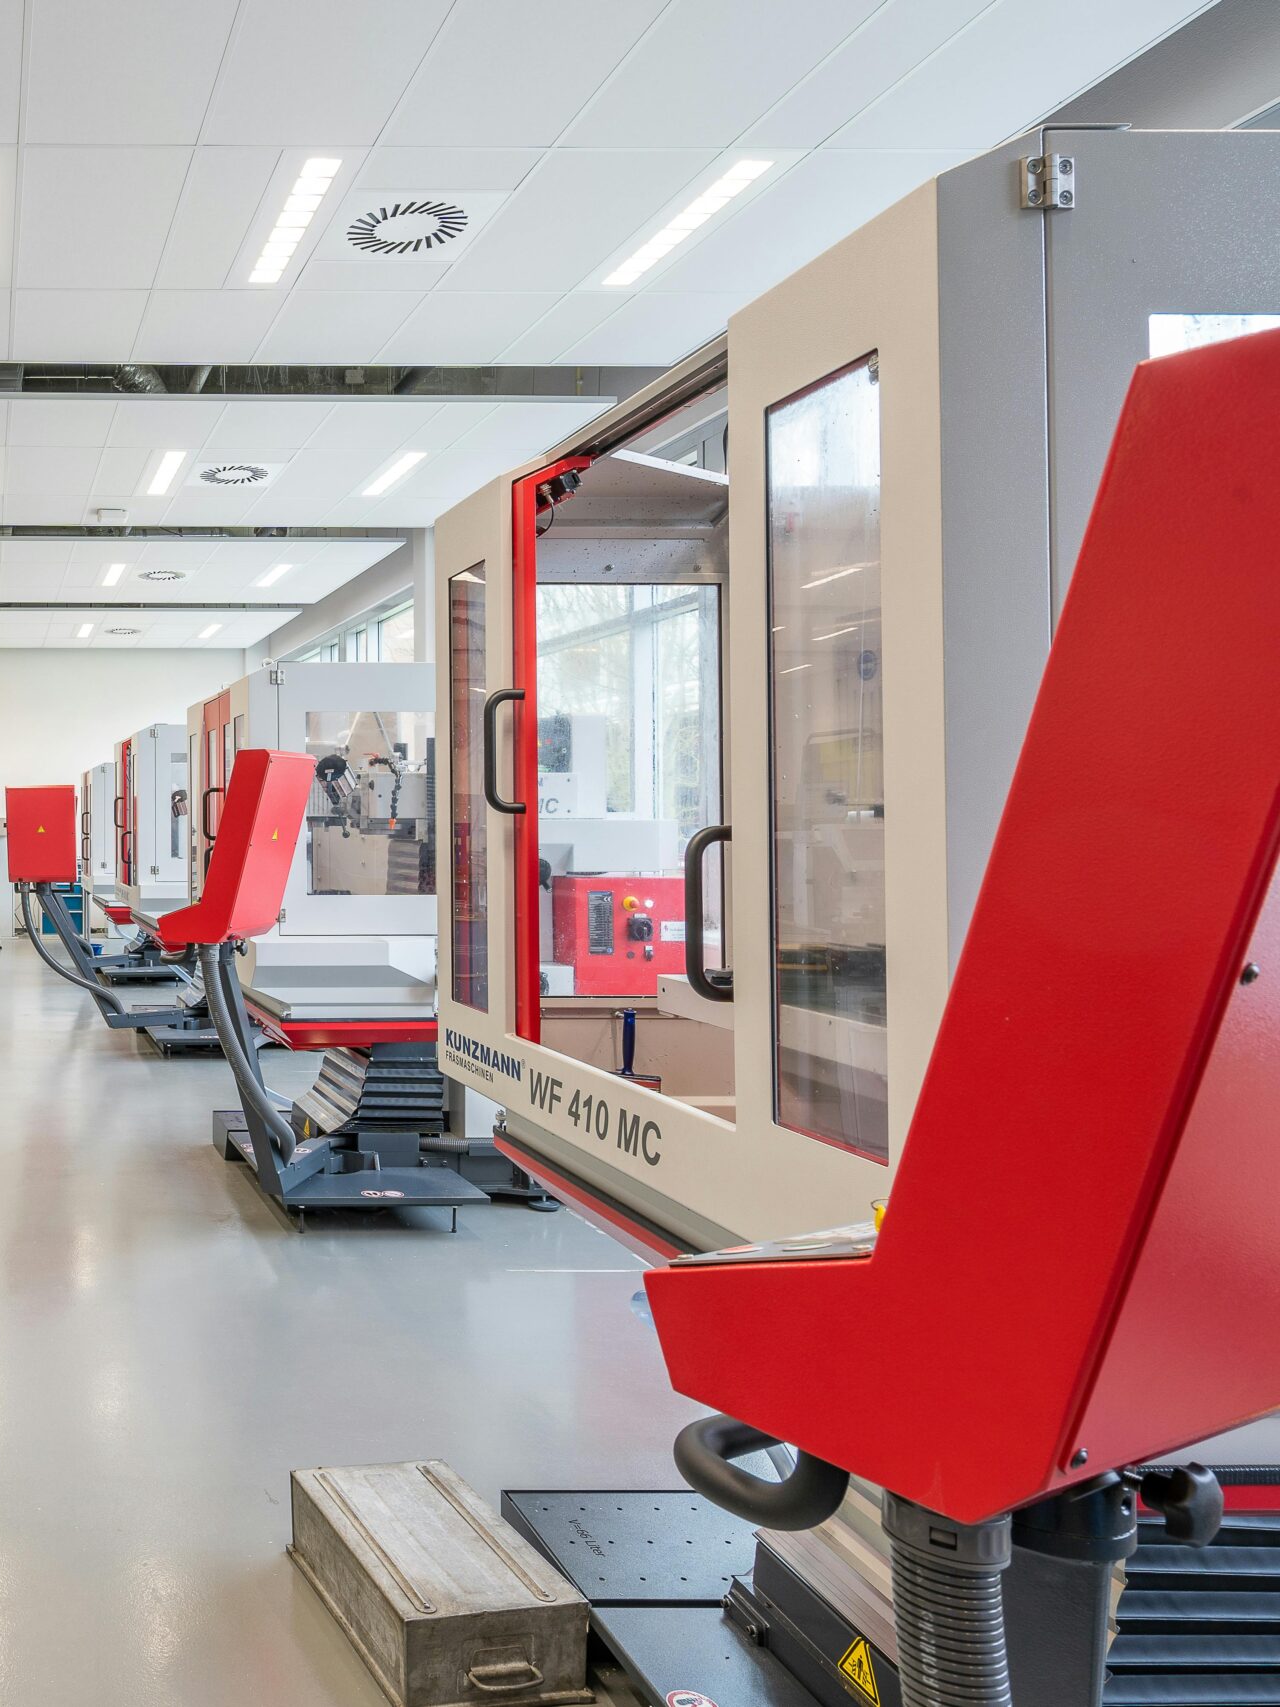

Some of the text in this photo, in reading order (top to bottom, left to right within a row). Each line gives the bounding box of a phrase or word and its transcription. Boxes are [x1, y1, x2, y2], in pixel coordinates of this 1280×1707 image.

[445, 1050, 494, 1083] FRÄSMASCHINEN
[529, 1068, 662, 1167] WF 410 MC
[568, 1519, 606, 1558] V=66 Liter
